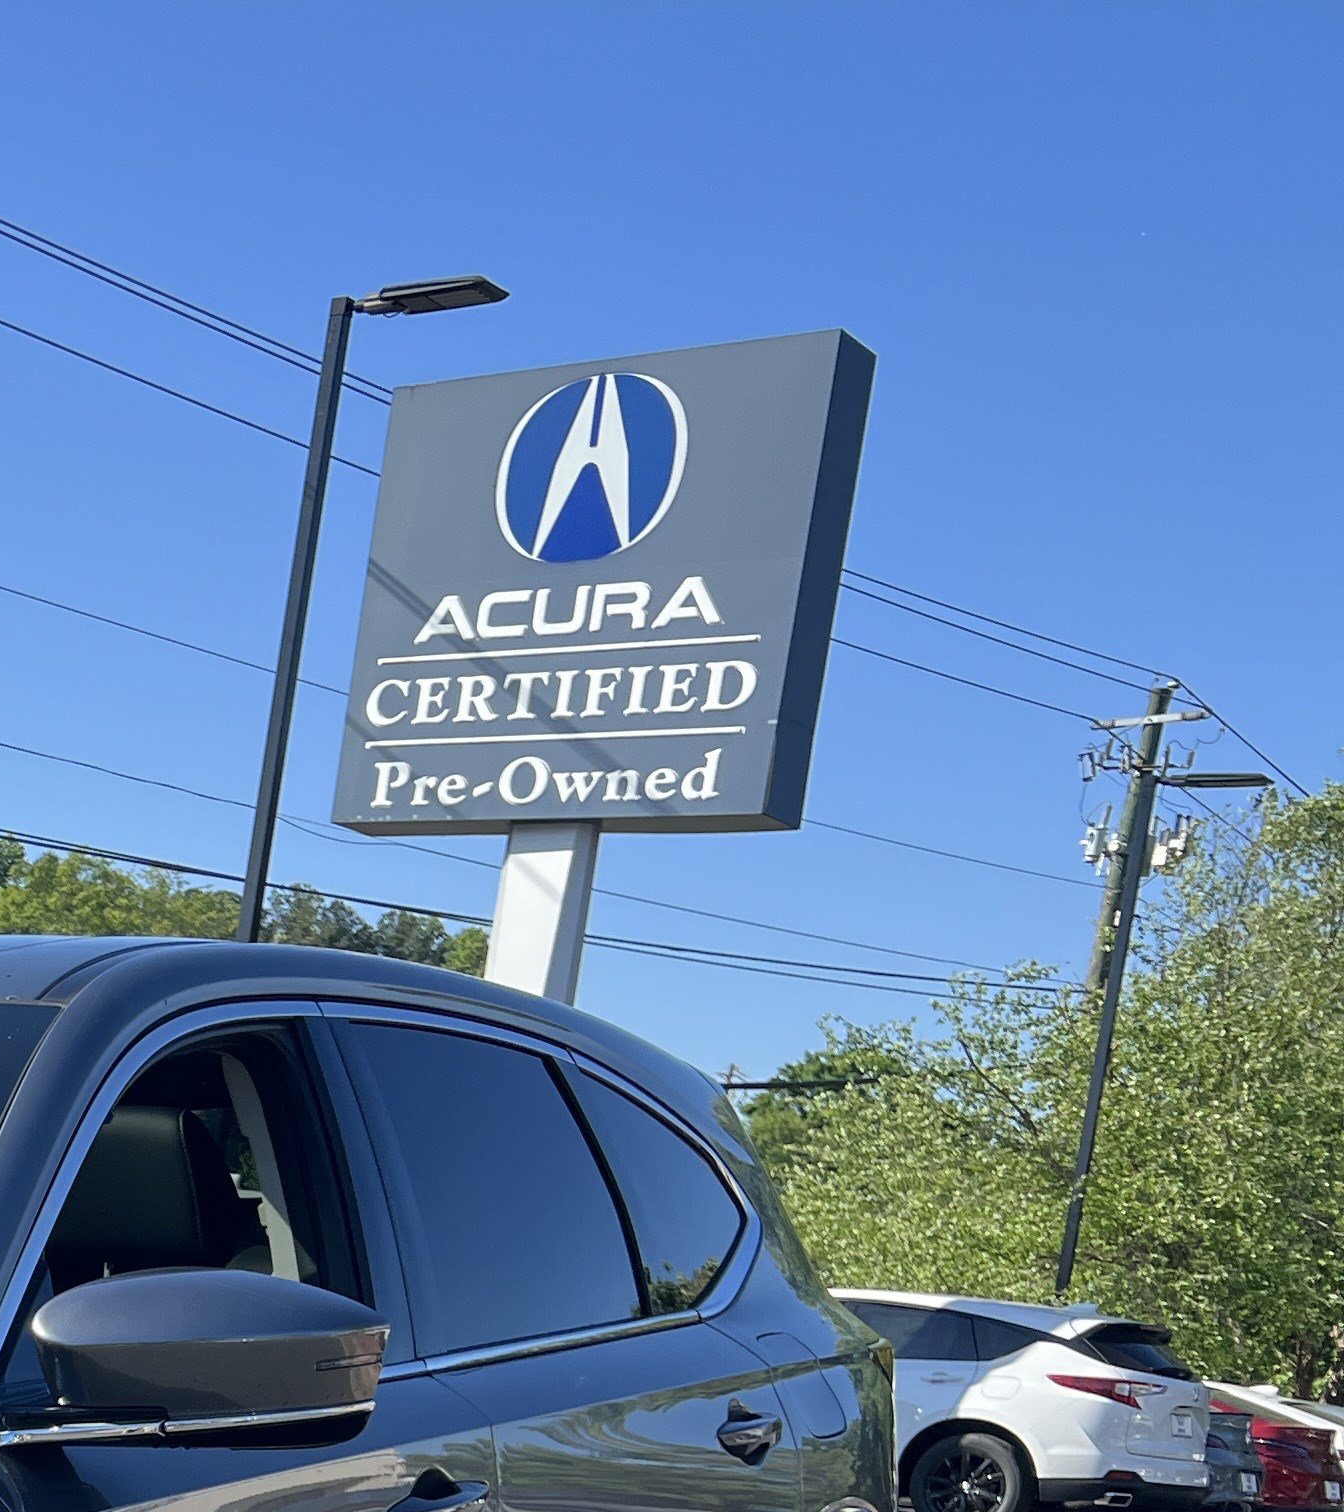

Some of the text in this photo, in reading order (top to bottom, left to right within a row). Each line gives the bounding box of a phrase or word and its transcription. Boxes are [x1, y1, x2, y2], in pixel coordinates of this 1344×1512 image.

[413, 575, 725, 646] ACURA
[365, 660, 759, 728] CERTIFIED
[368, 747, 723, 810] Pre-Owned
